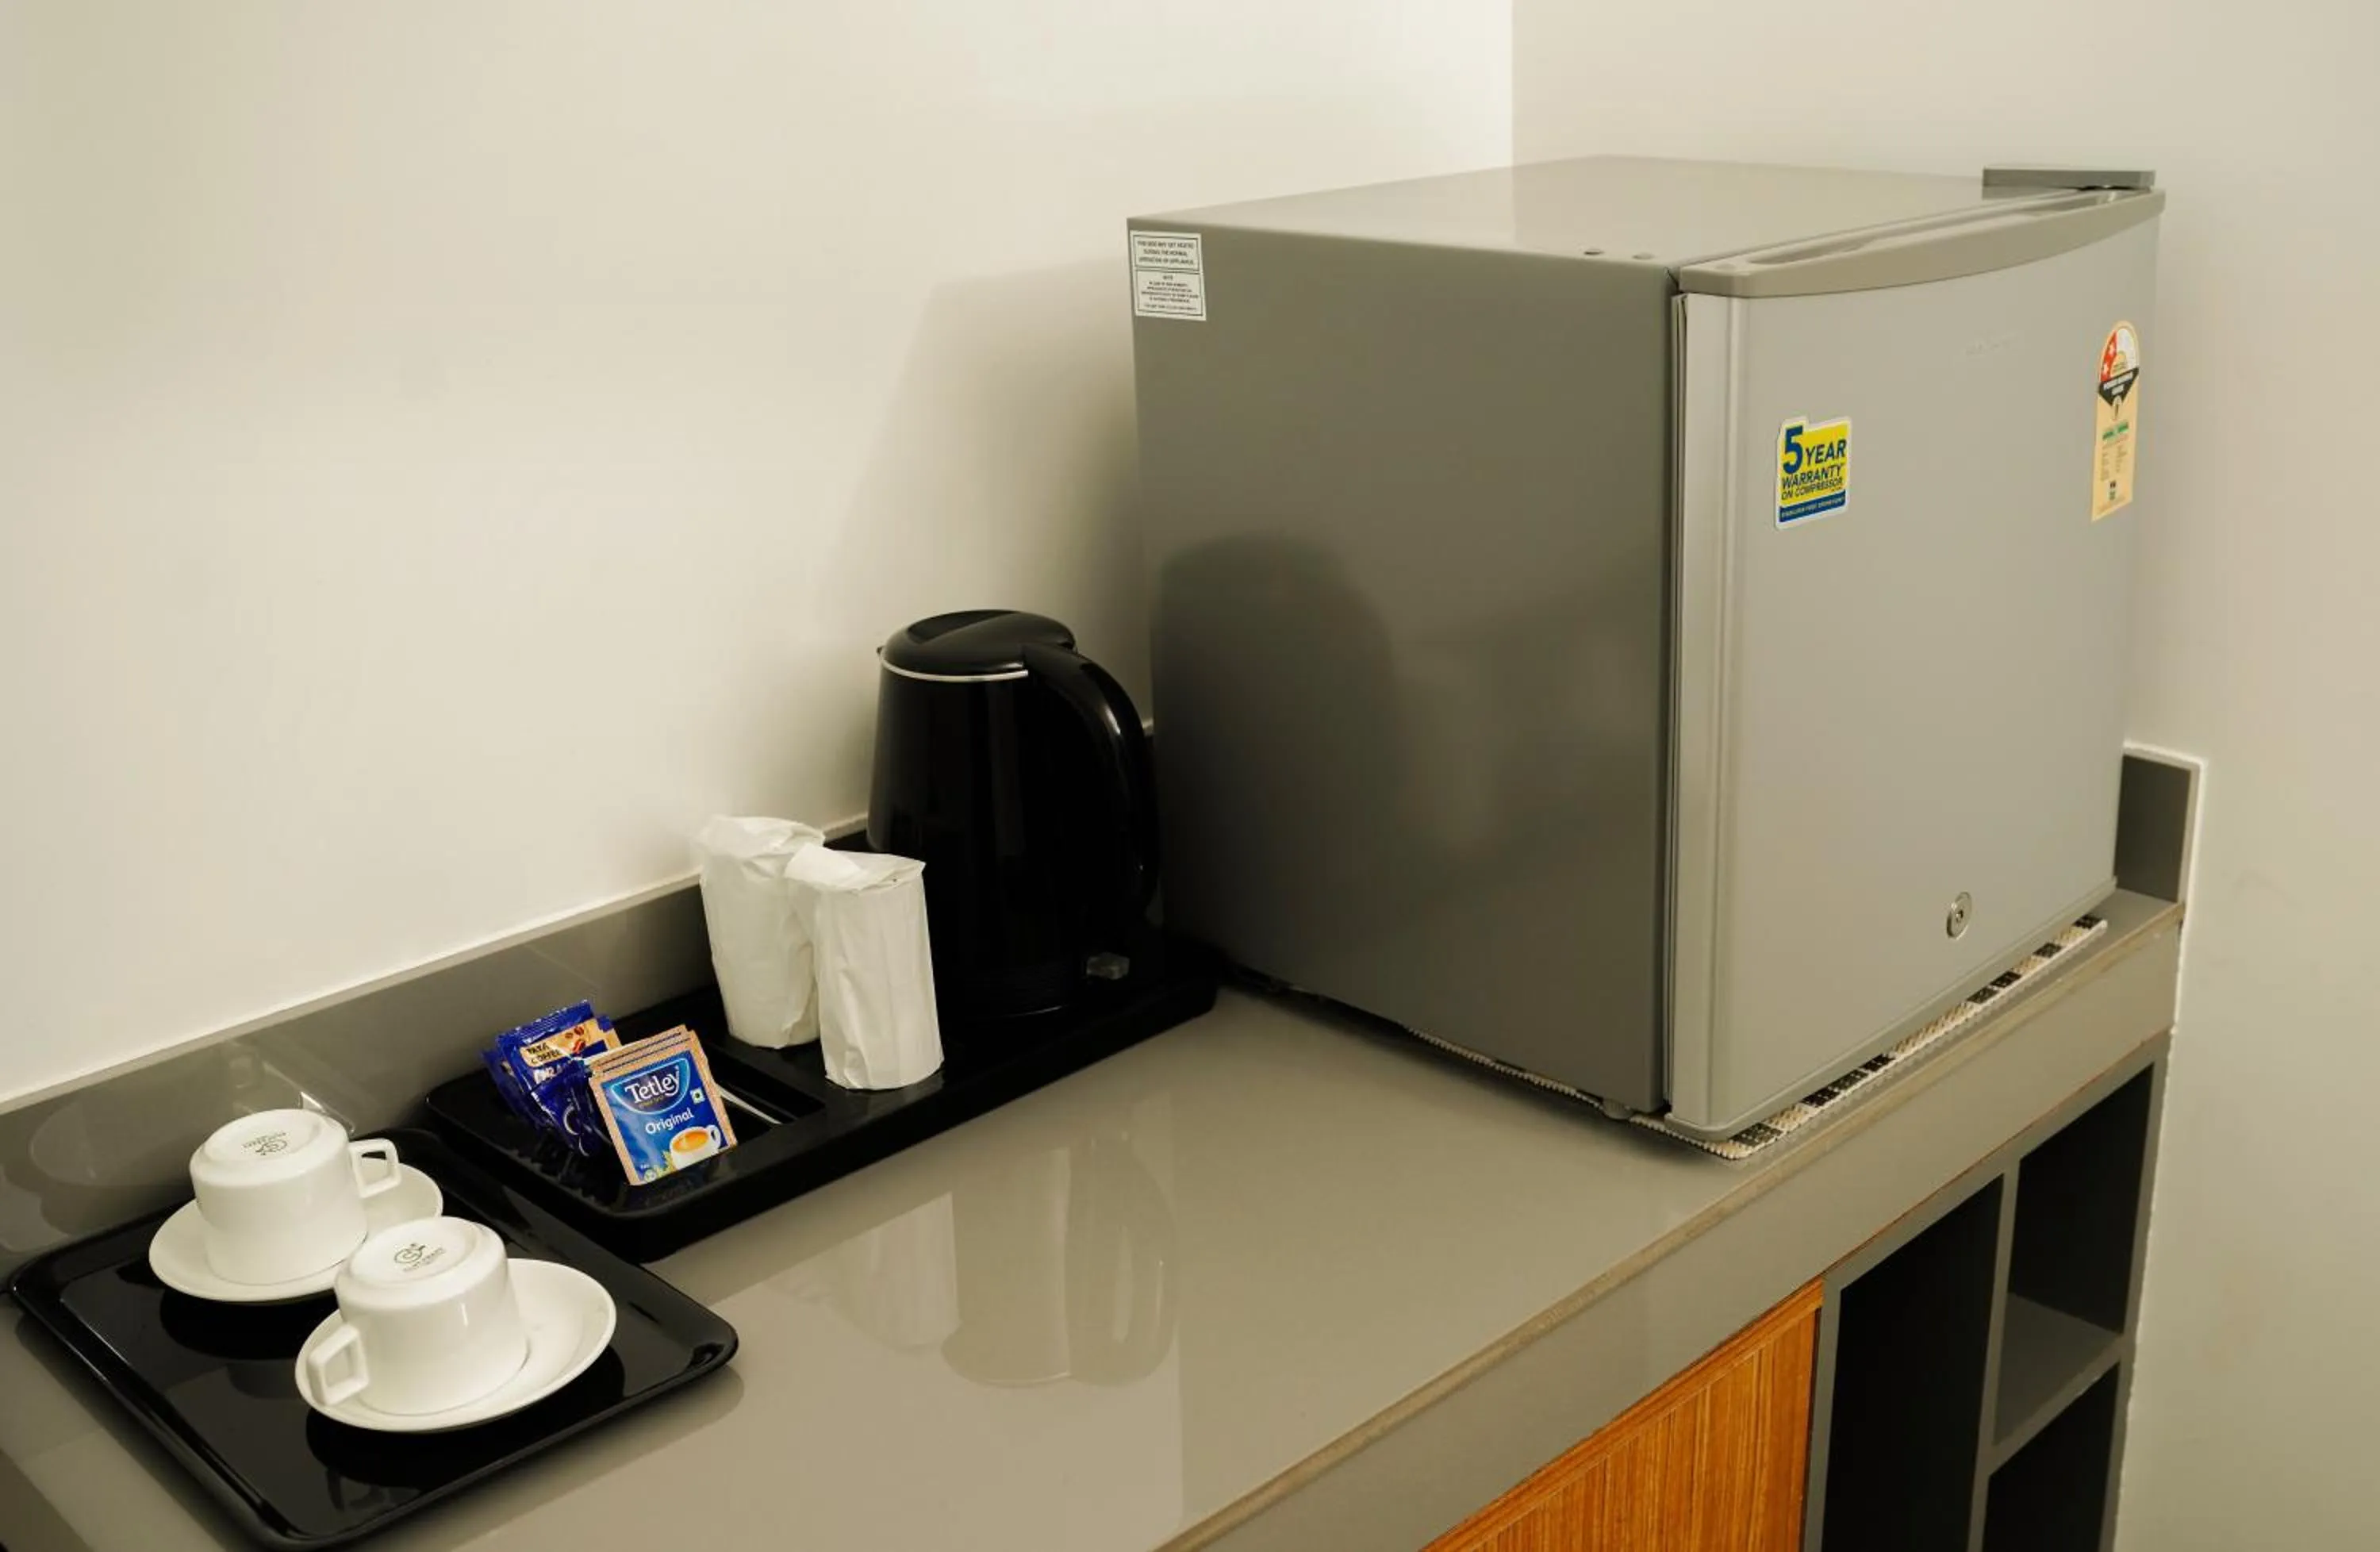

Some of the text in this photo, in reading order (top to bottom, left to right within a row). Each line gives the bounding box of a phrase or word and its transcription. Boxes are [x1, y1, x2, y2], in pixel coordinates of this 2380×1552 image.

[1783, 425, 1847, 474] 5 YEAR
[1781, 477, 1843, 501] ON COMPRESSOR
[624, 1065, 681, 1104] Tetley
[645, 1109, 694, 1135] Original
